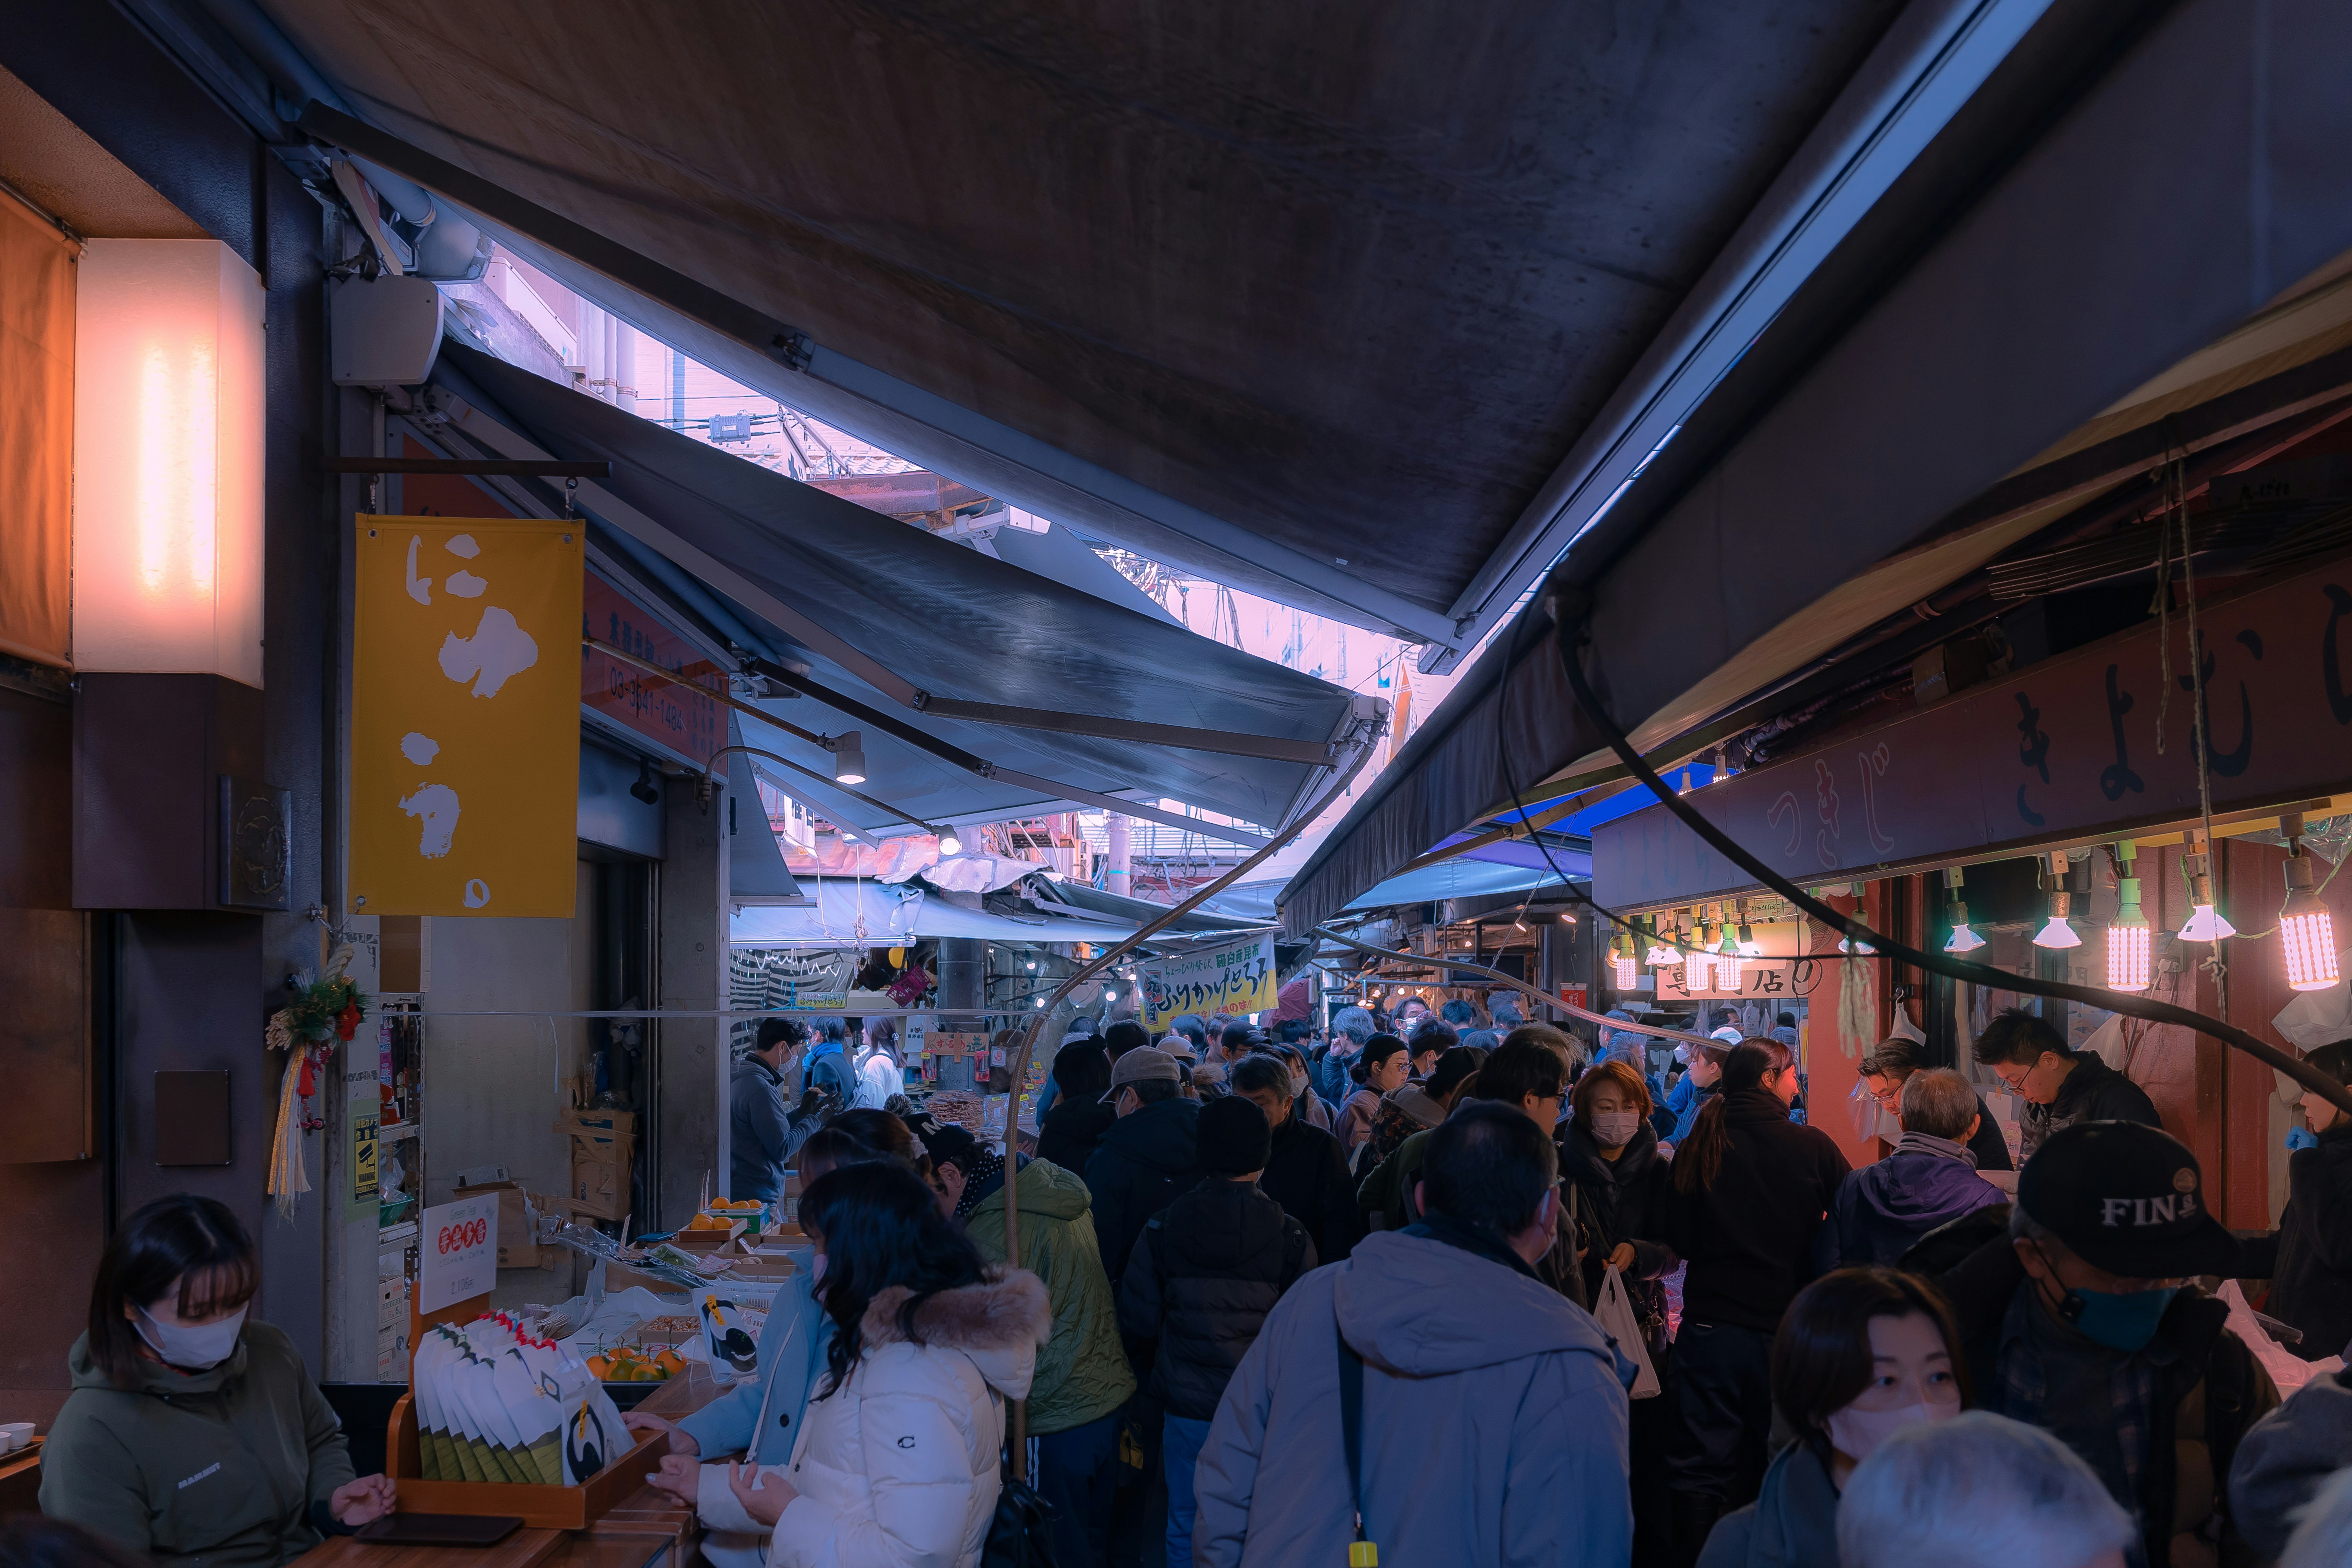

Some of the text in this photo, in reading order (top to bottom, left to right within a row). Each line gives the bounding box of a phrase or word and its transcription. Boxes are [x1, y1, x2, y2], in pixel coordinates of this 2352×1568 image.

[610, 666, 683, 735] 03-3541-1484
[1767, 741, 1895, 870] つきじ
[1157, 957, 1268, 1013] ふりかけとろろ
[1165, 943, 1260, 979] ちょっぴり贅沢 羅臼産昆布
